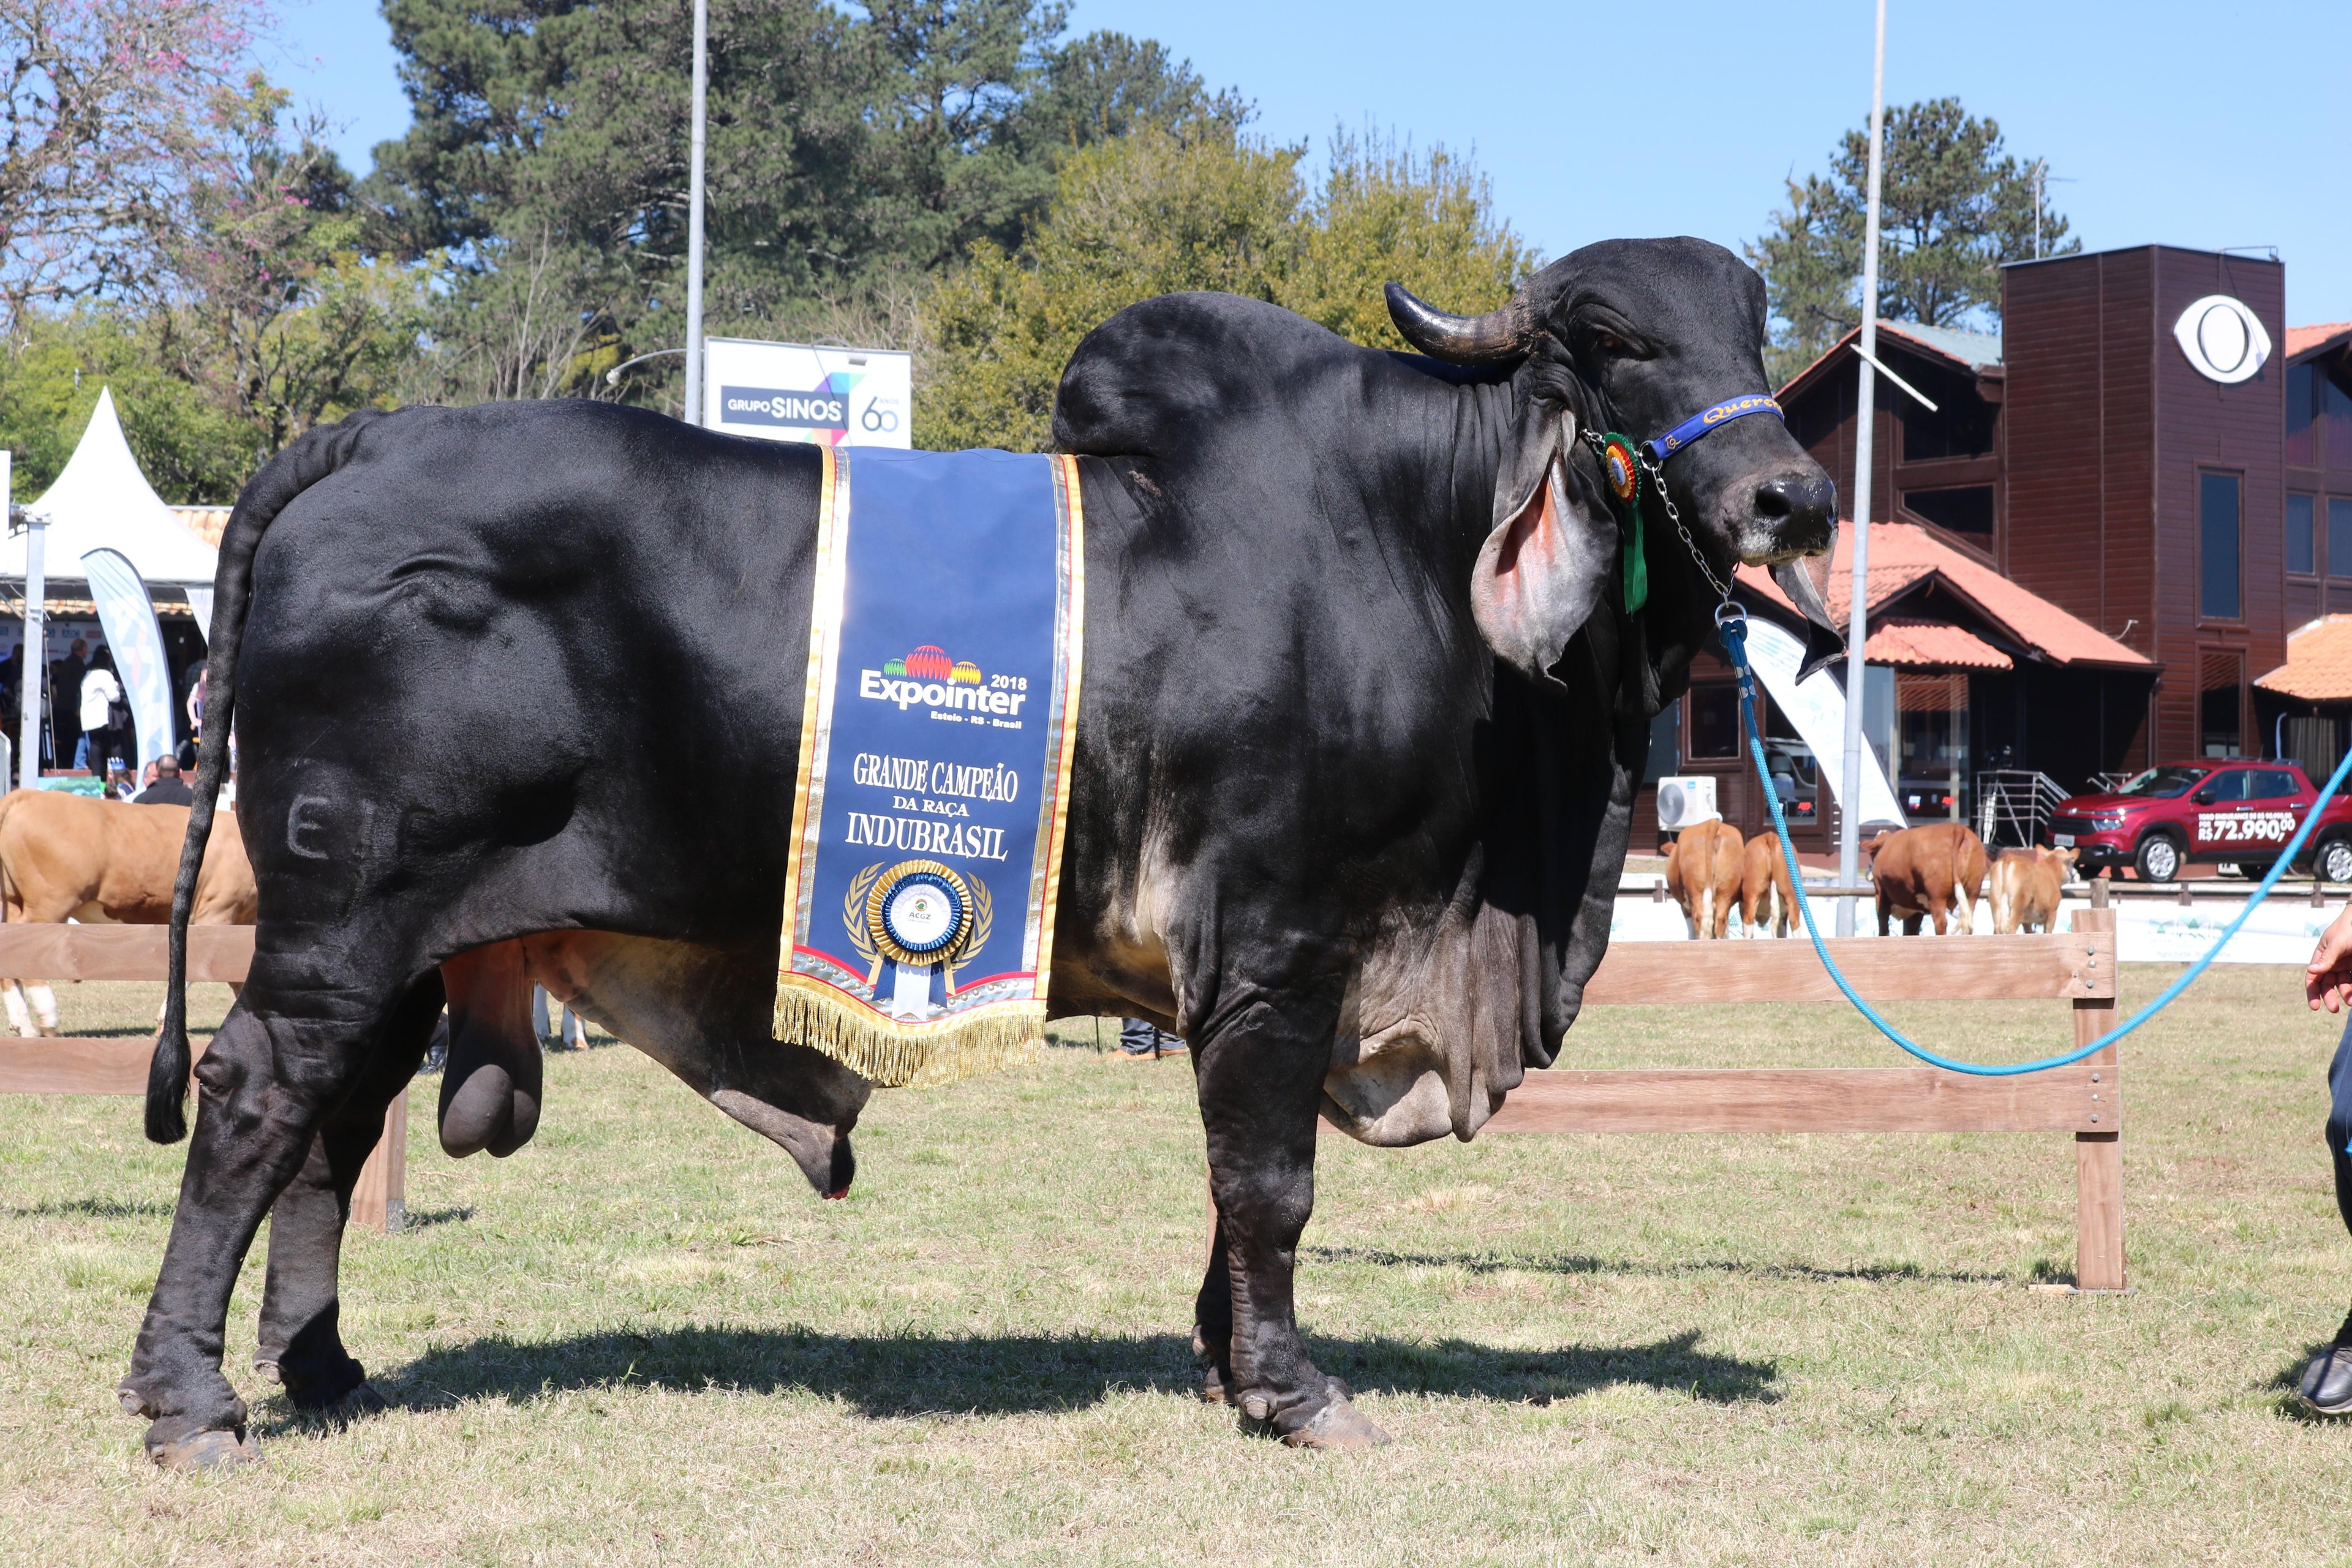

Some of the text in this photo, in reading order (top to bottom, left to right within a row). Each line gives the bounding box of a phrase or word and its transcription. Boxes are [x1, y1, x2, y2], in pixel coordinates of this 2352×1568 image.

[728, 396, 843, 422] GRUPO SINOS
[861, 395, 899, 432] 60
[860, 669, 1027, 715] Expointer
[990, 674, 1027, 691] 2018
[930, 710, 963, 722] Esteio
[970, 715, 985, 725] RS
[992, 718, 1022, 729] Brasil
[853, 752, 1018, 803] GRANDE CAMPEÃO
[892, 796, 970, 818] DA RAÇA
[845, 812, 1008, 862] INDUBRASIL
[2198, 828, 2213, 842] R$
